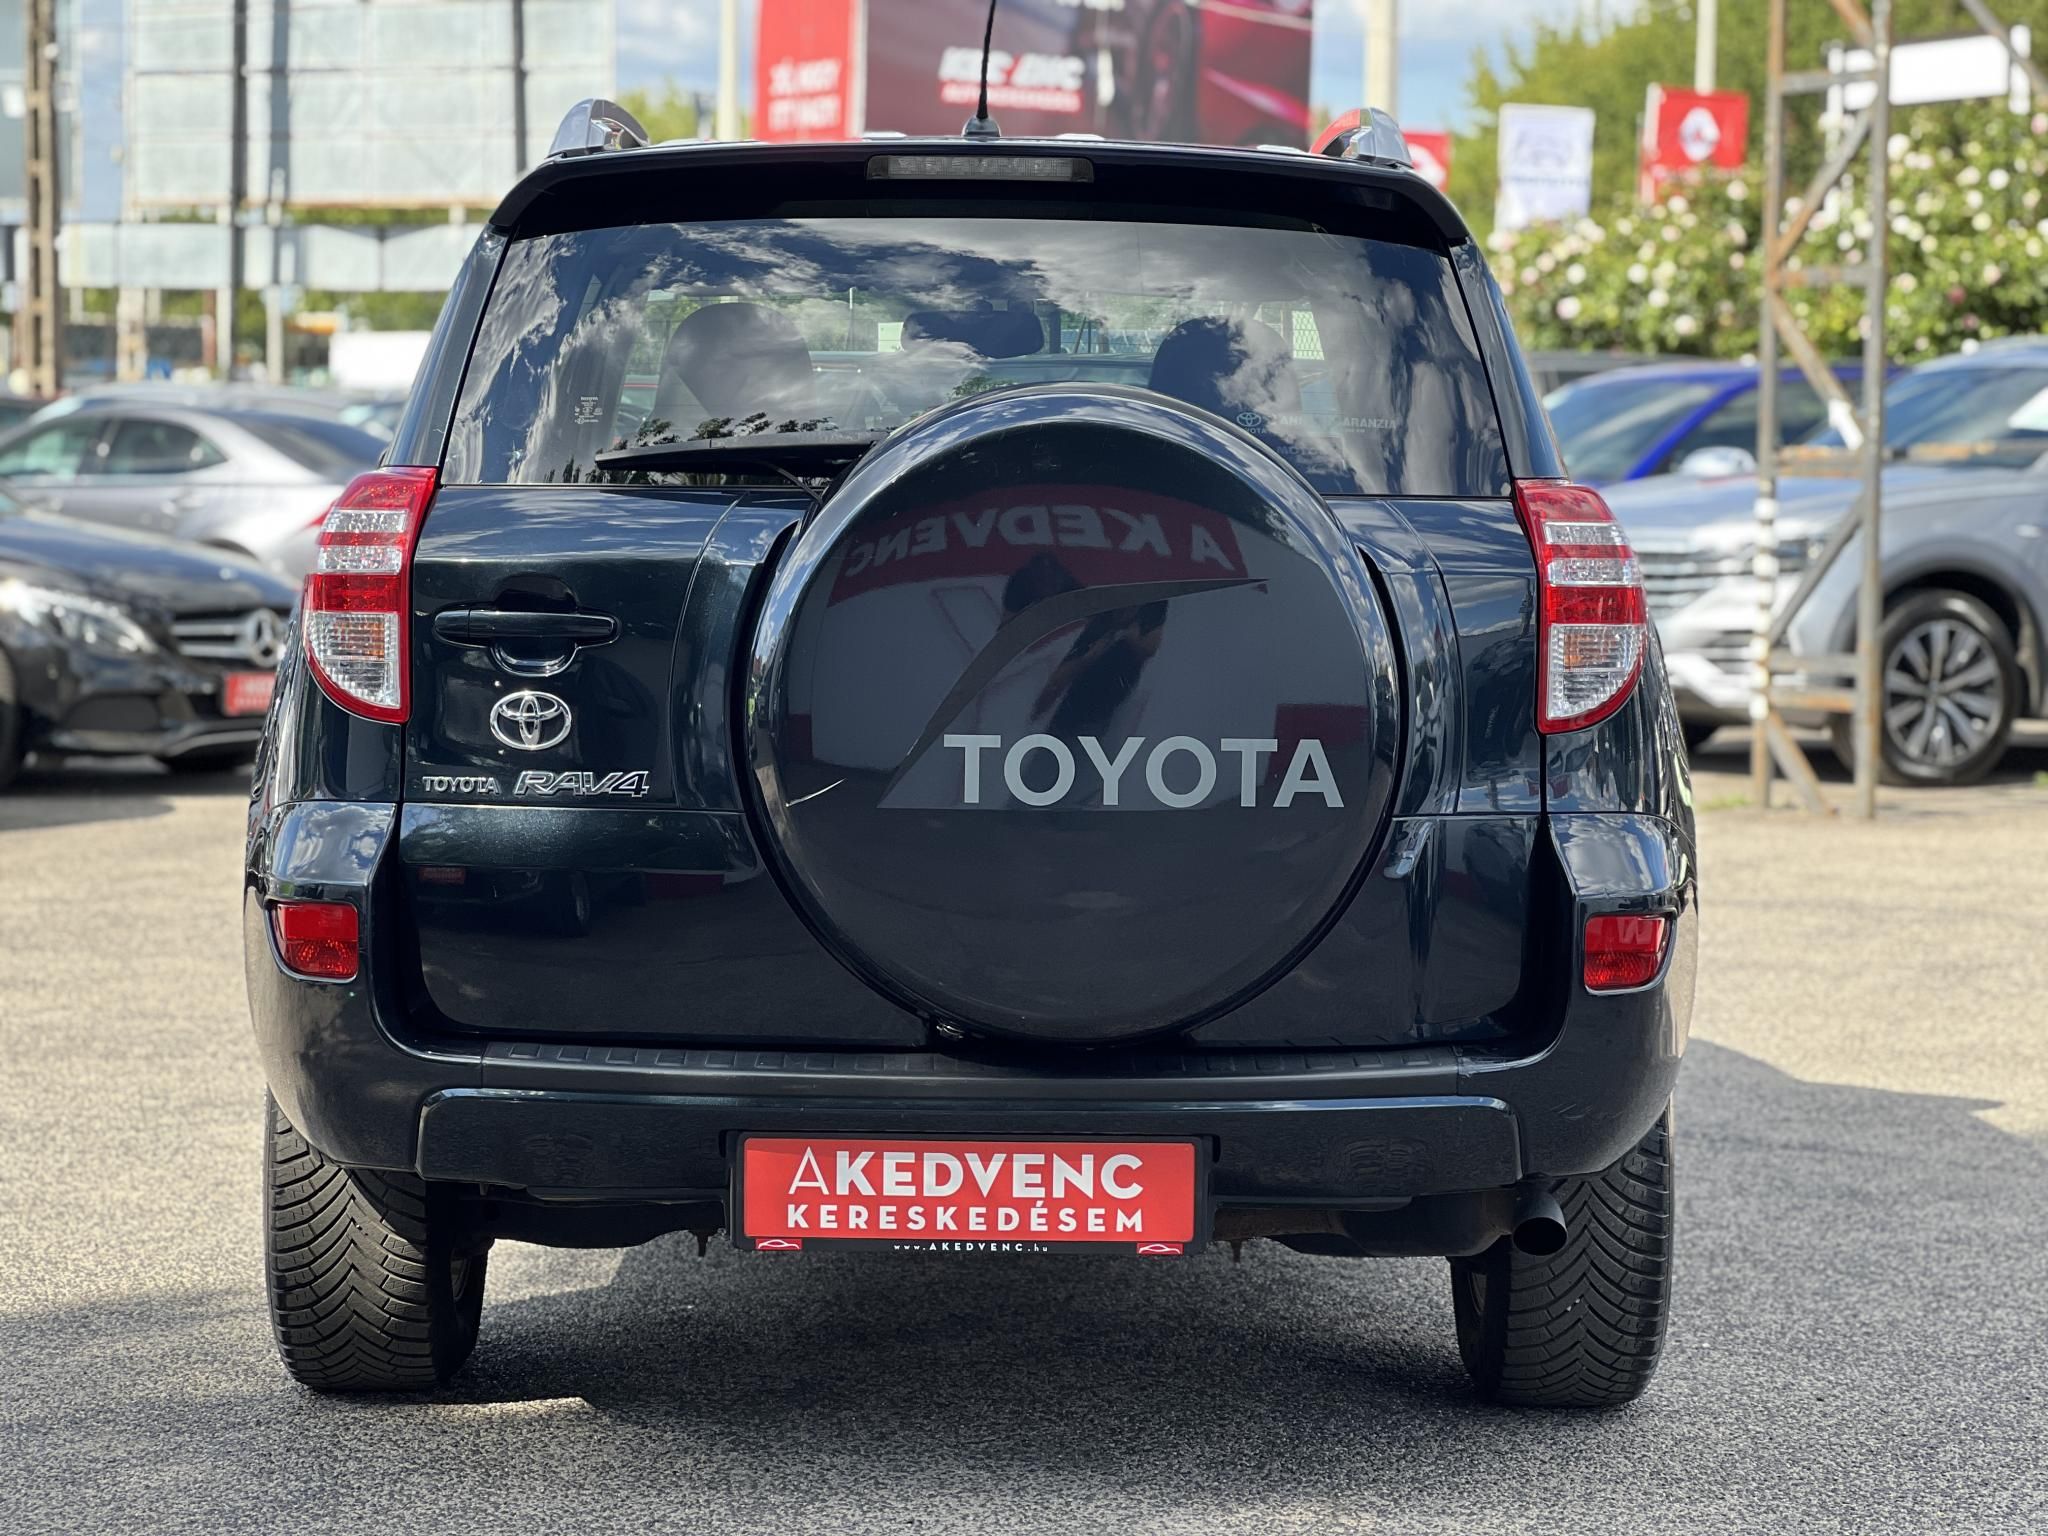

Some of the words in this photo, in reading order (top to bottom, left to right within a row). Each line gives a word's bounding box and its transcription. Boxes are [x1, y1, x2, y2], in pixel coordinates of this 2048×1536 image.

[1342, 416, 1397, 429] ARANZIA
[422, 775, 500, 795] TOYOTA
[513, 770, 650, 798] RAV4
[943, 733, 1345, 809] TOYOTA
[786, 1201, 1144, 1233] KERESKEDÉSEM
[893, 1242, 1049, 1253] www.AKEDVENC.hu
